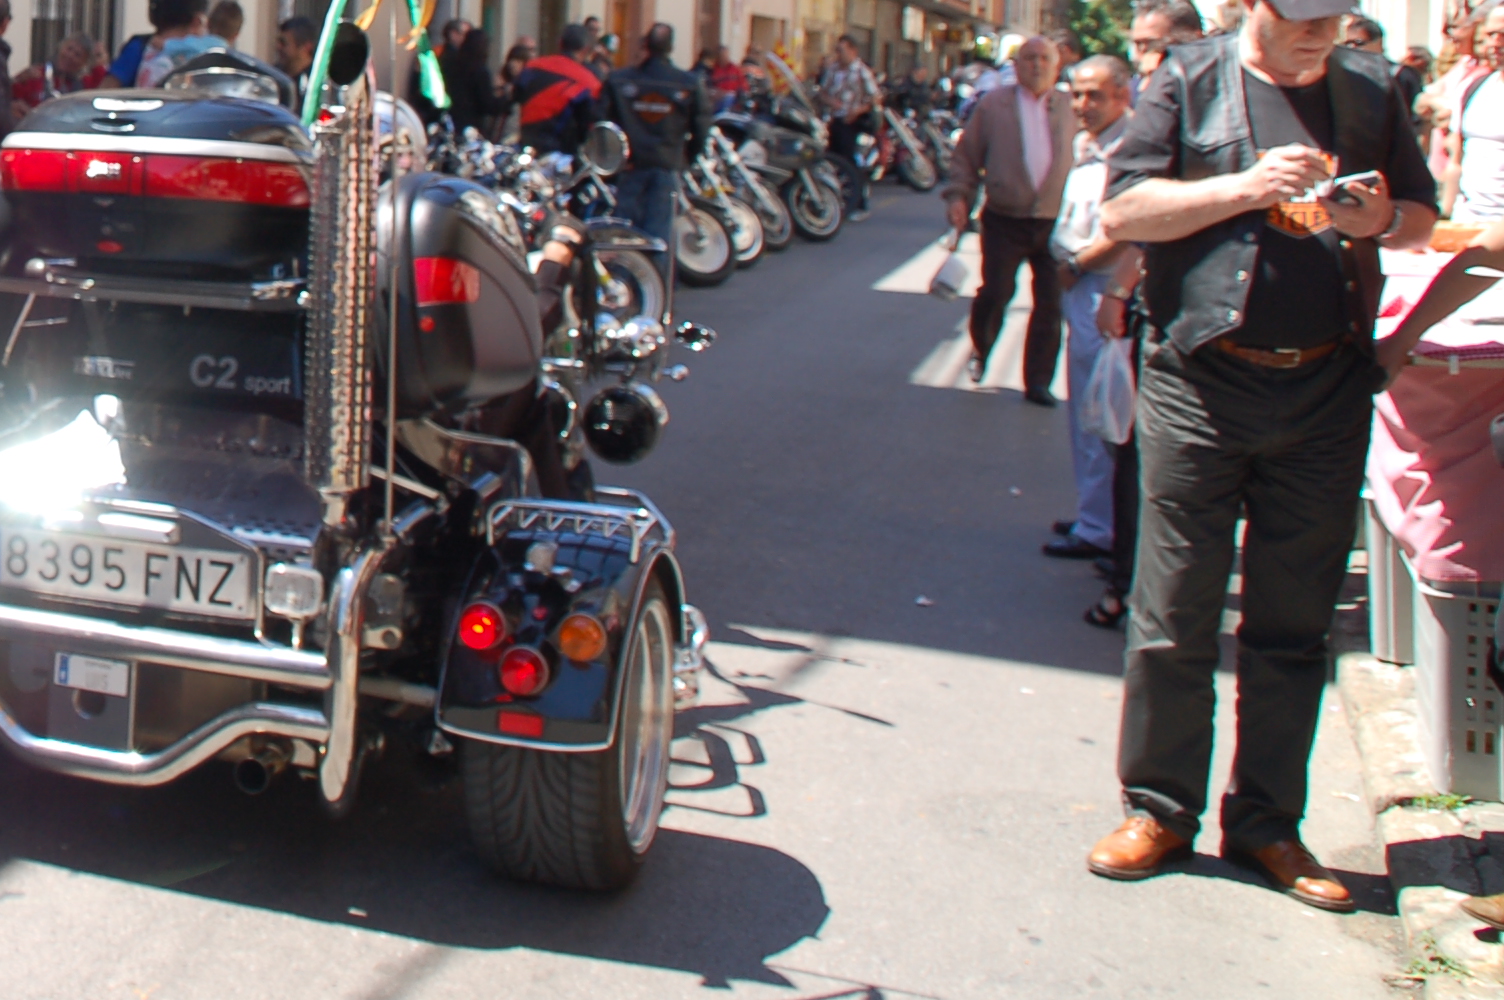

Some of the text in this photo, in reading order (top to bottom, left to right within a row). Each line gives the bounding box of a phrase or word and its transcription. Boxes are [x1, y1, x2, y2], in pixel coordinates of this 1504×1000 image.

[189, 353, 292, 396] C2 sport
[5, 534, 127, 591] 8395
[144, 551, 235, 607] FNZ
